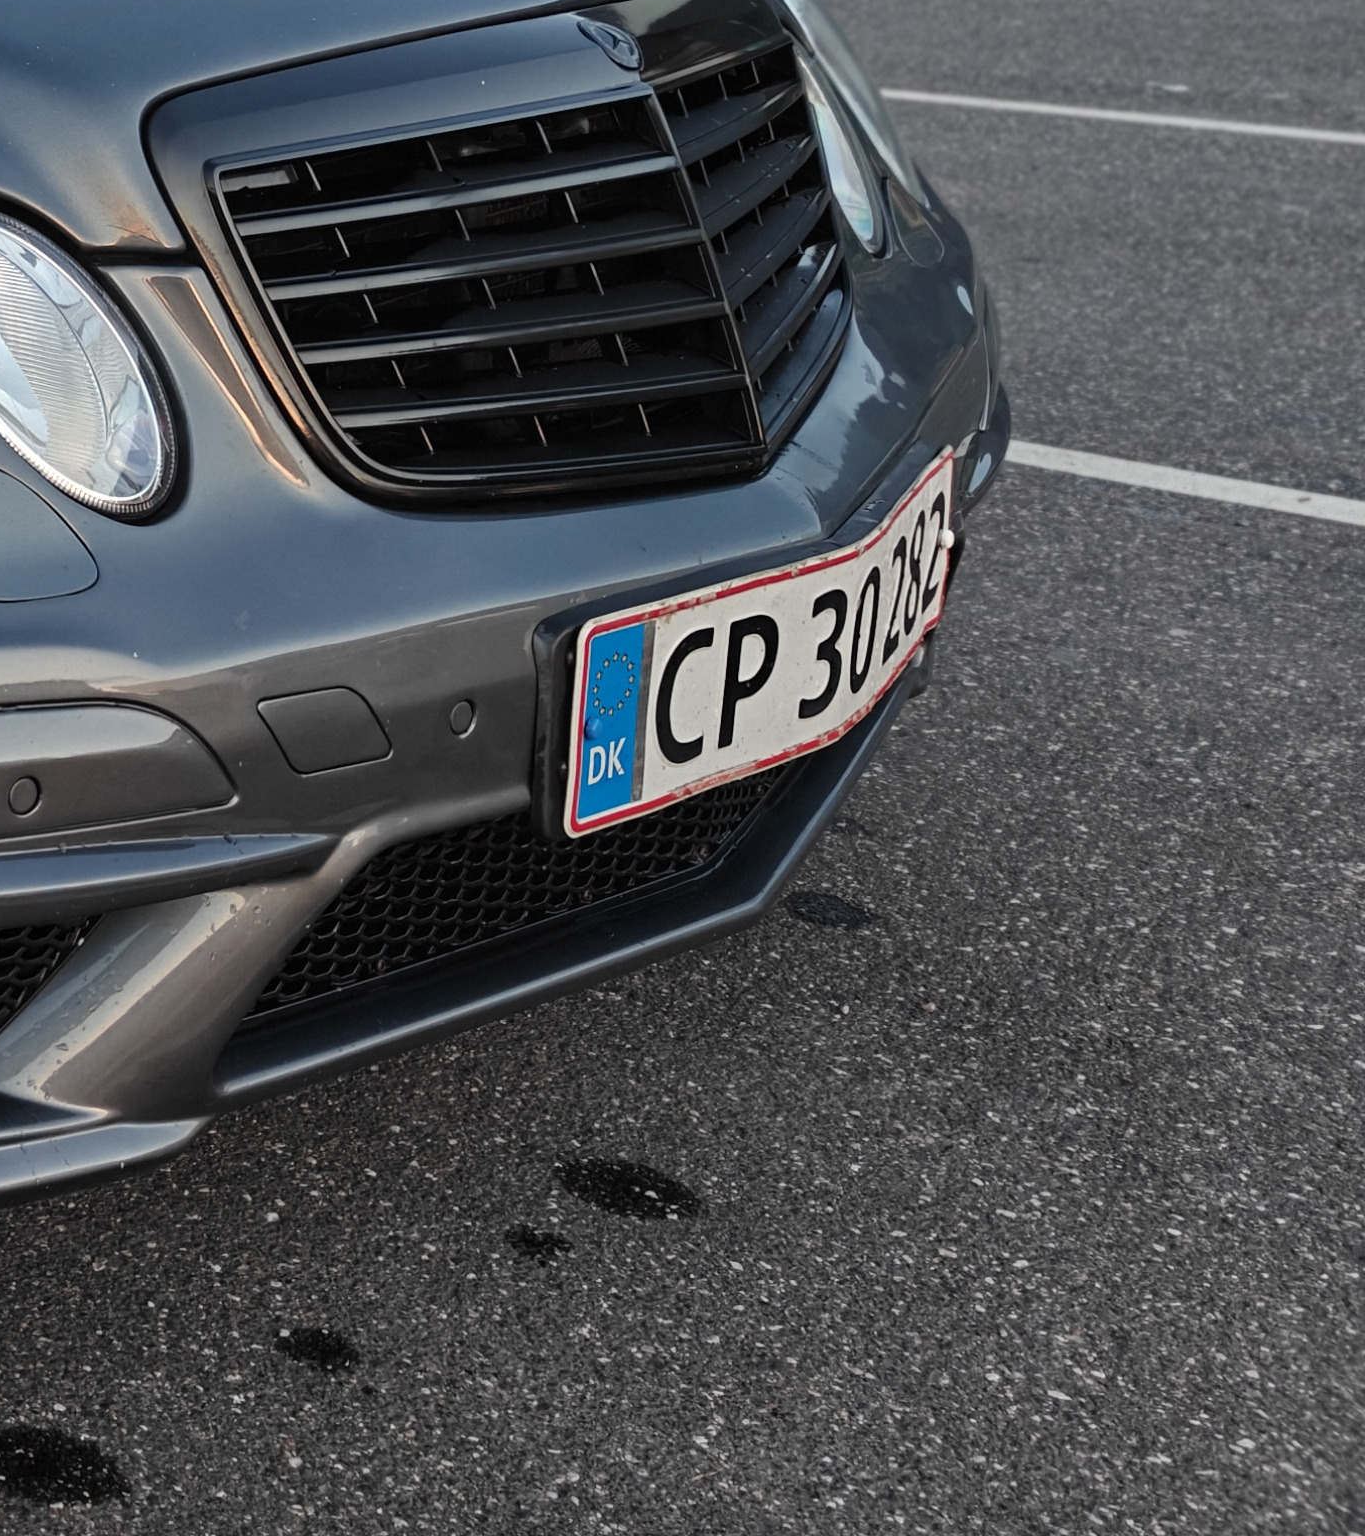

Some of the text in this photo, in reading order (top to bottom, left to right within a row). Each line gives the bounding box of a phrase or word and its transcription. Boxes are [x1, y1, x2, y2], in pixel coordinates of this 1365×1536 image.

[655, 614, 779, 765] CP
[798, 565, 881, 720] 30
[587, 736, 626, 786] DK
